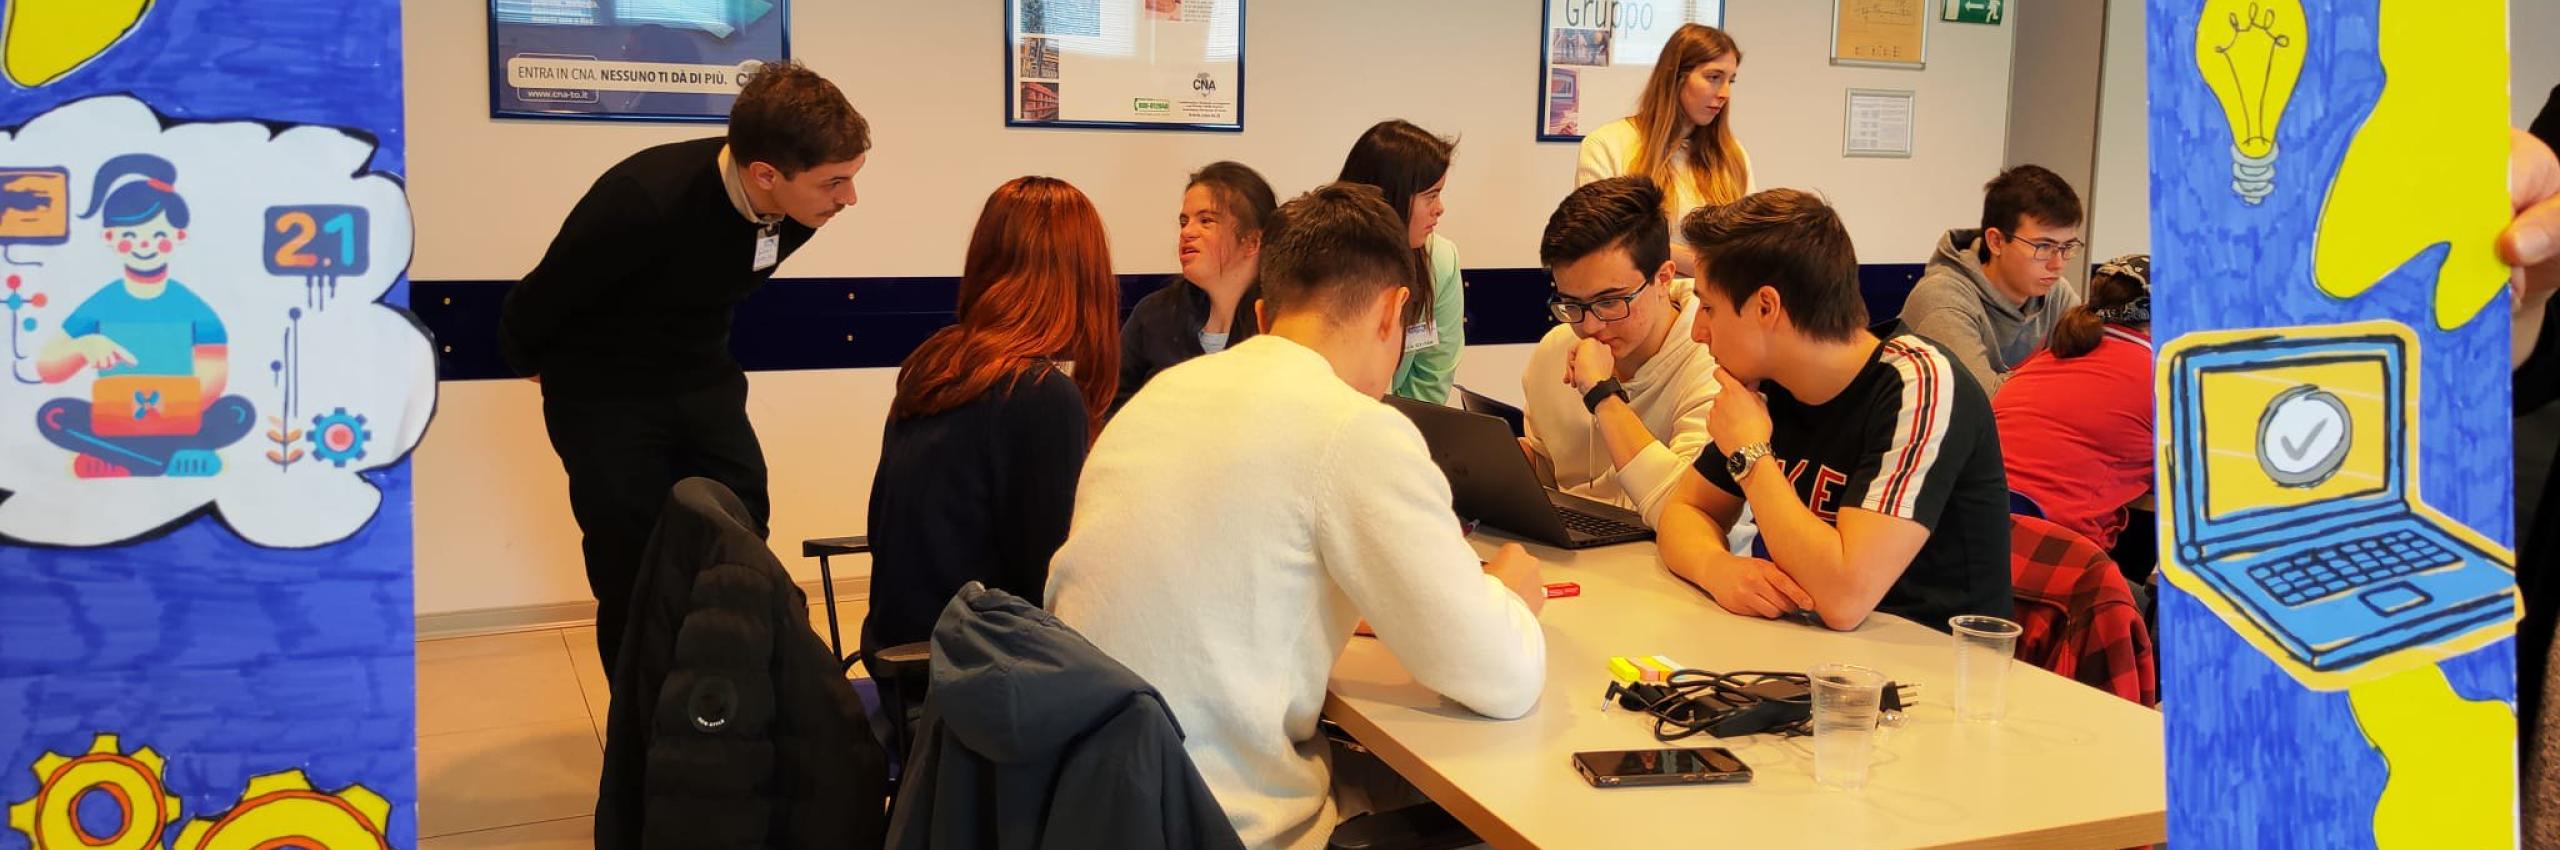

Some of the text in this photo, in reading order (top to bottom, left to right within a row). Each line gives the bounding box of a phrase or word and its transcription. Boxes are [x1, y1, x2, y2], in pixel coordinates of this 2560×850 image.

[1565, 0, 1653, 39] Gruppo
[518, 66, 555, 79] ENTRA
[556, 67, 568, 79] IN
[600, 69, 656, 82] NESSUNO
[658, 71, 668, 82] TI
[671, 69, 687, 84] DÀ
[689, 72, 701, 84] DI
[704, 70, 728, 85] PIÙ.
[1193, 78, 1216, 91] CNA
[274, 211, 356, 268] 2.1
